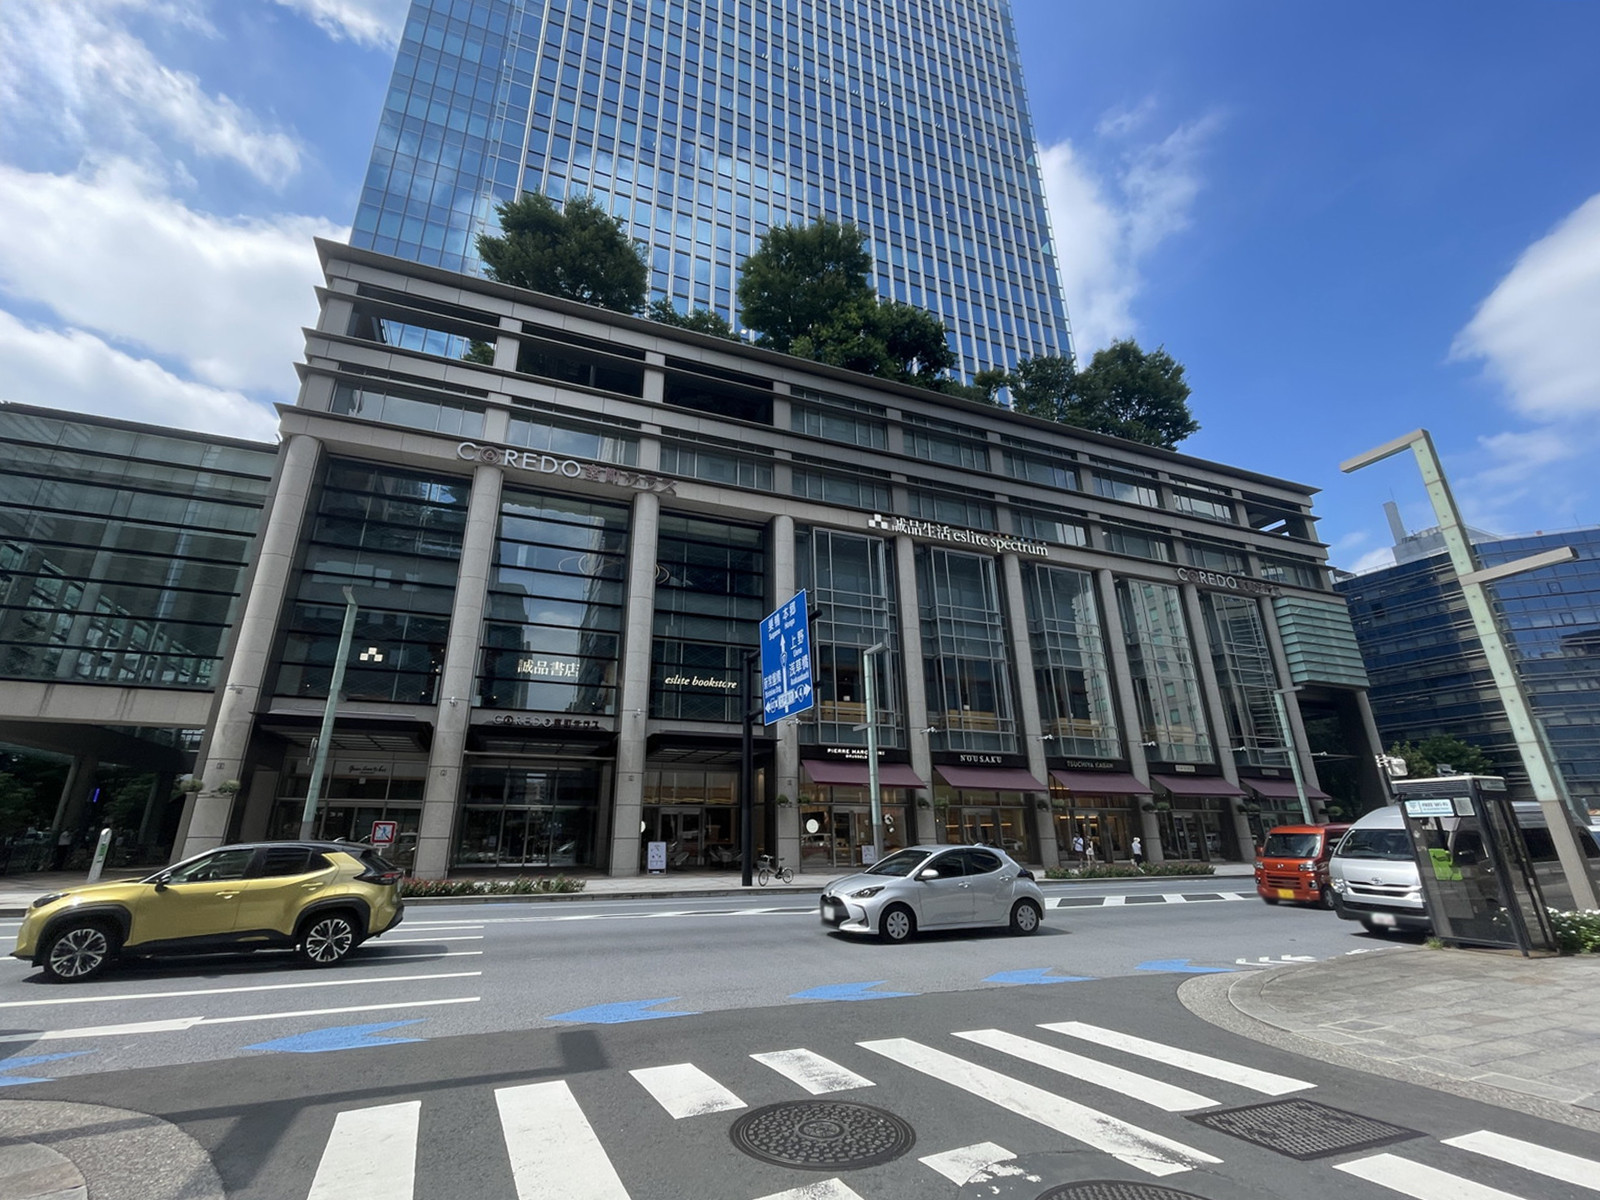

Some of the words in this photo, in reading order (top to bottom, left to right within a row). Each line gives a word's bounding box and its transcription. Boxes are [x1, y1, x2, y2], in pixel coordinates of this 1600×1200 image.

[456, 441, 582, 478] COREDO
[953, 529, 989, 547] eslite
[990, 535, 1049, 557] spectrum
[1177, 567, 1238, 590] COREDO
[517, 658, 580, 678] 誠品書店
[664, 674, 690, 686] eslite
[692, 675, 738, 689] bookstore
[960, 754, 1002, 764] NOUSAKU
